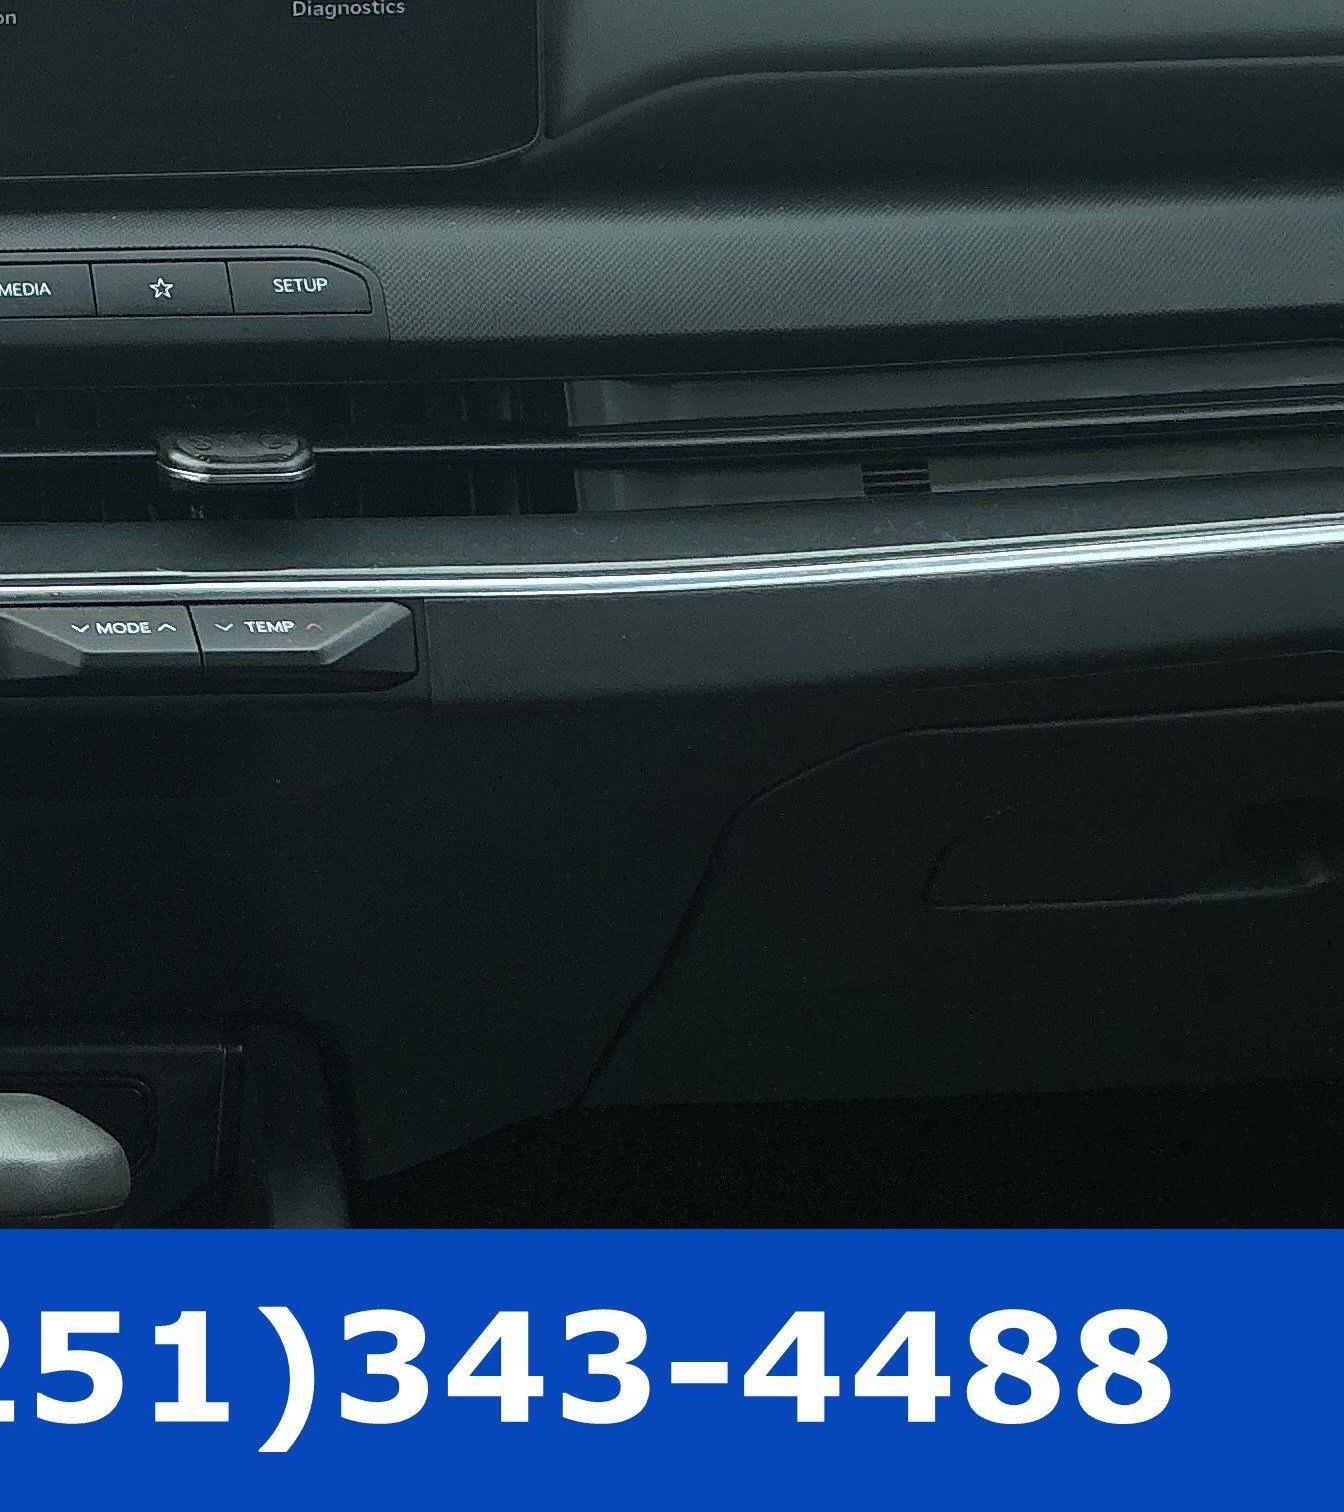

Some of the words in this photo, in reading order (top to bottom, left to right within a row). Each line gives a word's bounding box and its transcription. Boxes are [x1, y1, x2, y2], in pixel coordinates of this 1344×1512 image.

[293, 0, 405, 19] Diagnostics
[274, 278, 327, 292] SETUP
[97, 622, 151, 633] MODE
[245, 621, 294, 632] TEMP
